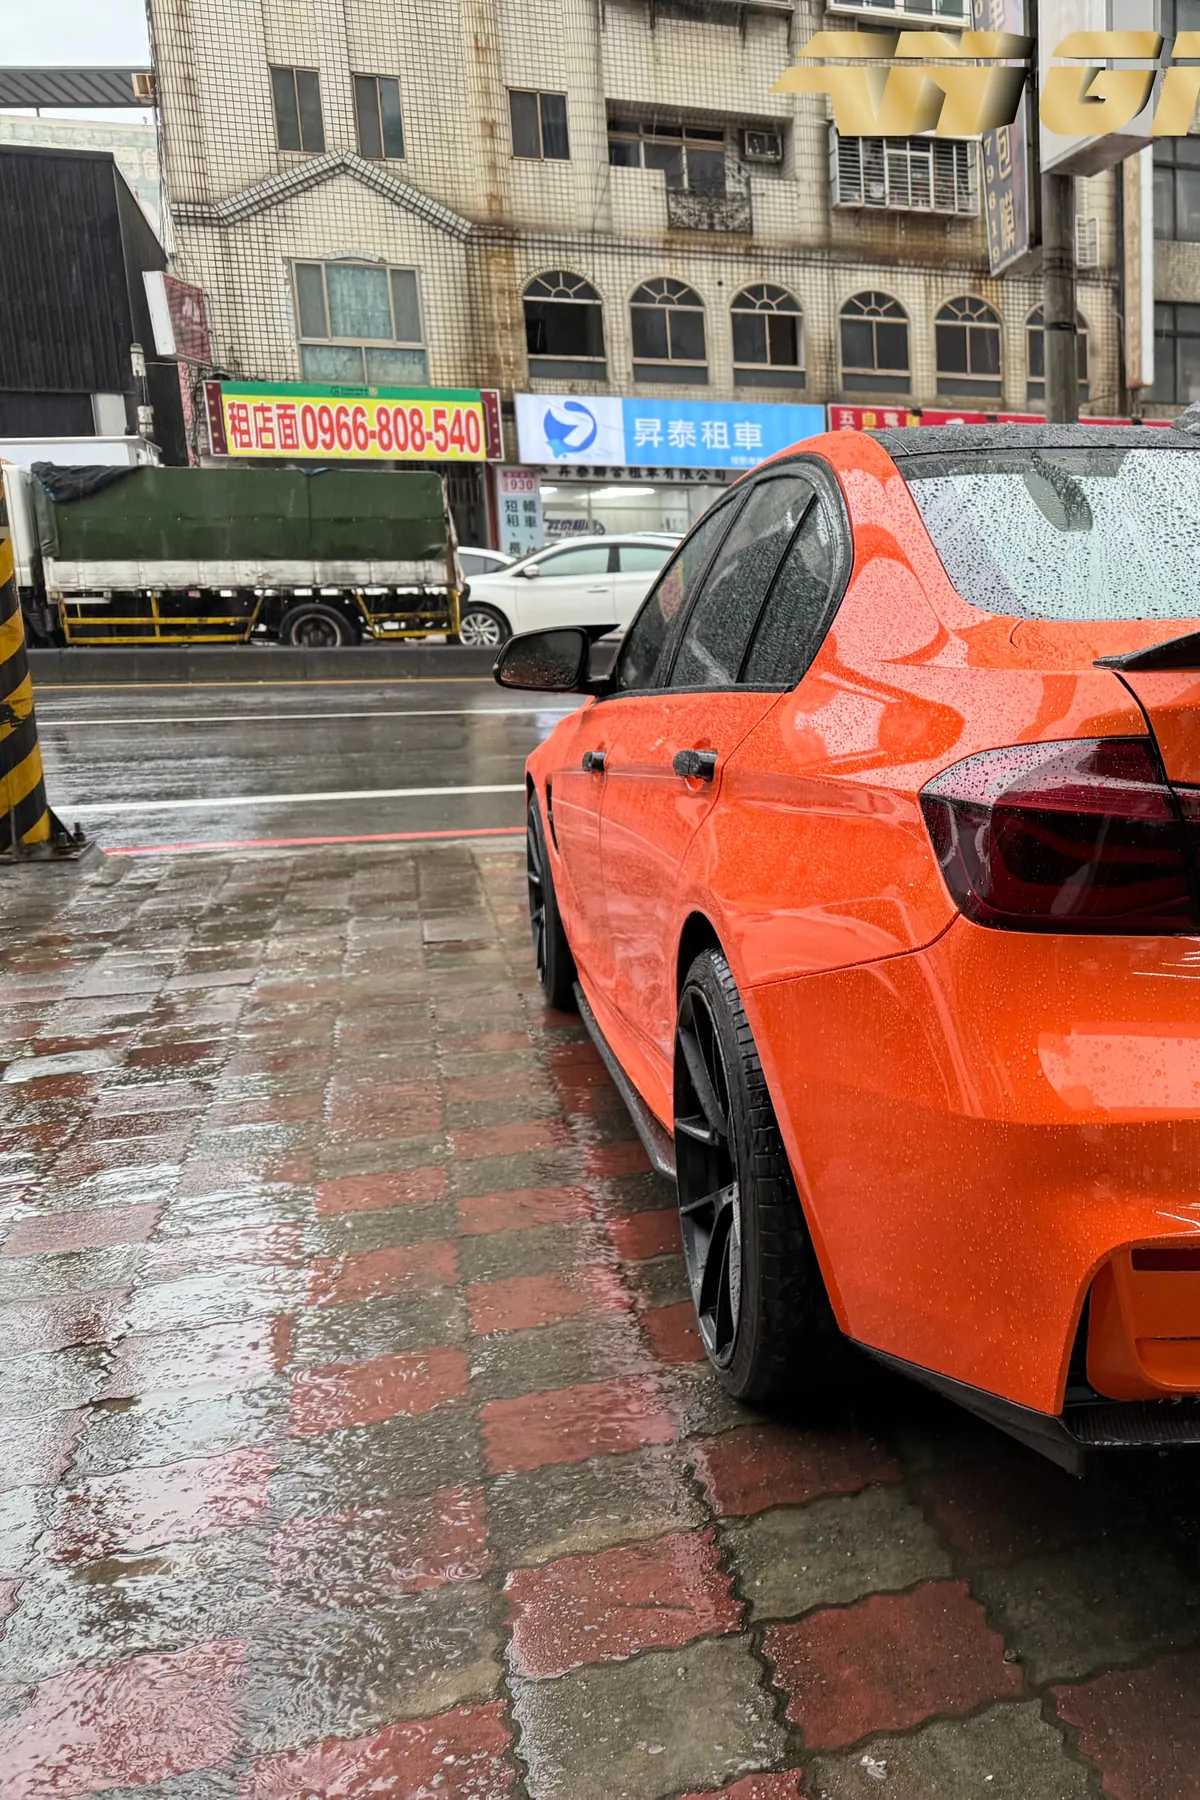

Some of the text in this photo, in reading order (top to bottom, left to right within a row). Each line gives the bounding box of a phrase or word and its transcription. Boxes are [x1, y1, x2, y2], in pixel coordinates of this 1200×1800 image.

[633, 418, 764, 450] 昇泰租車
[510, 479, 534, 491] 930
